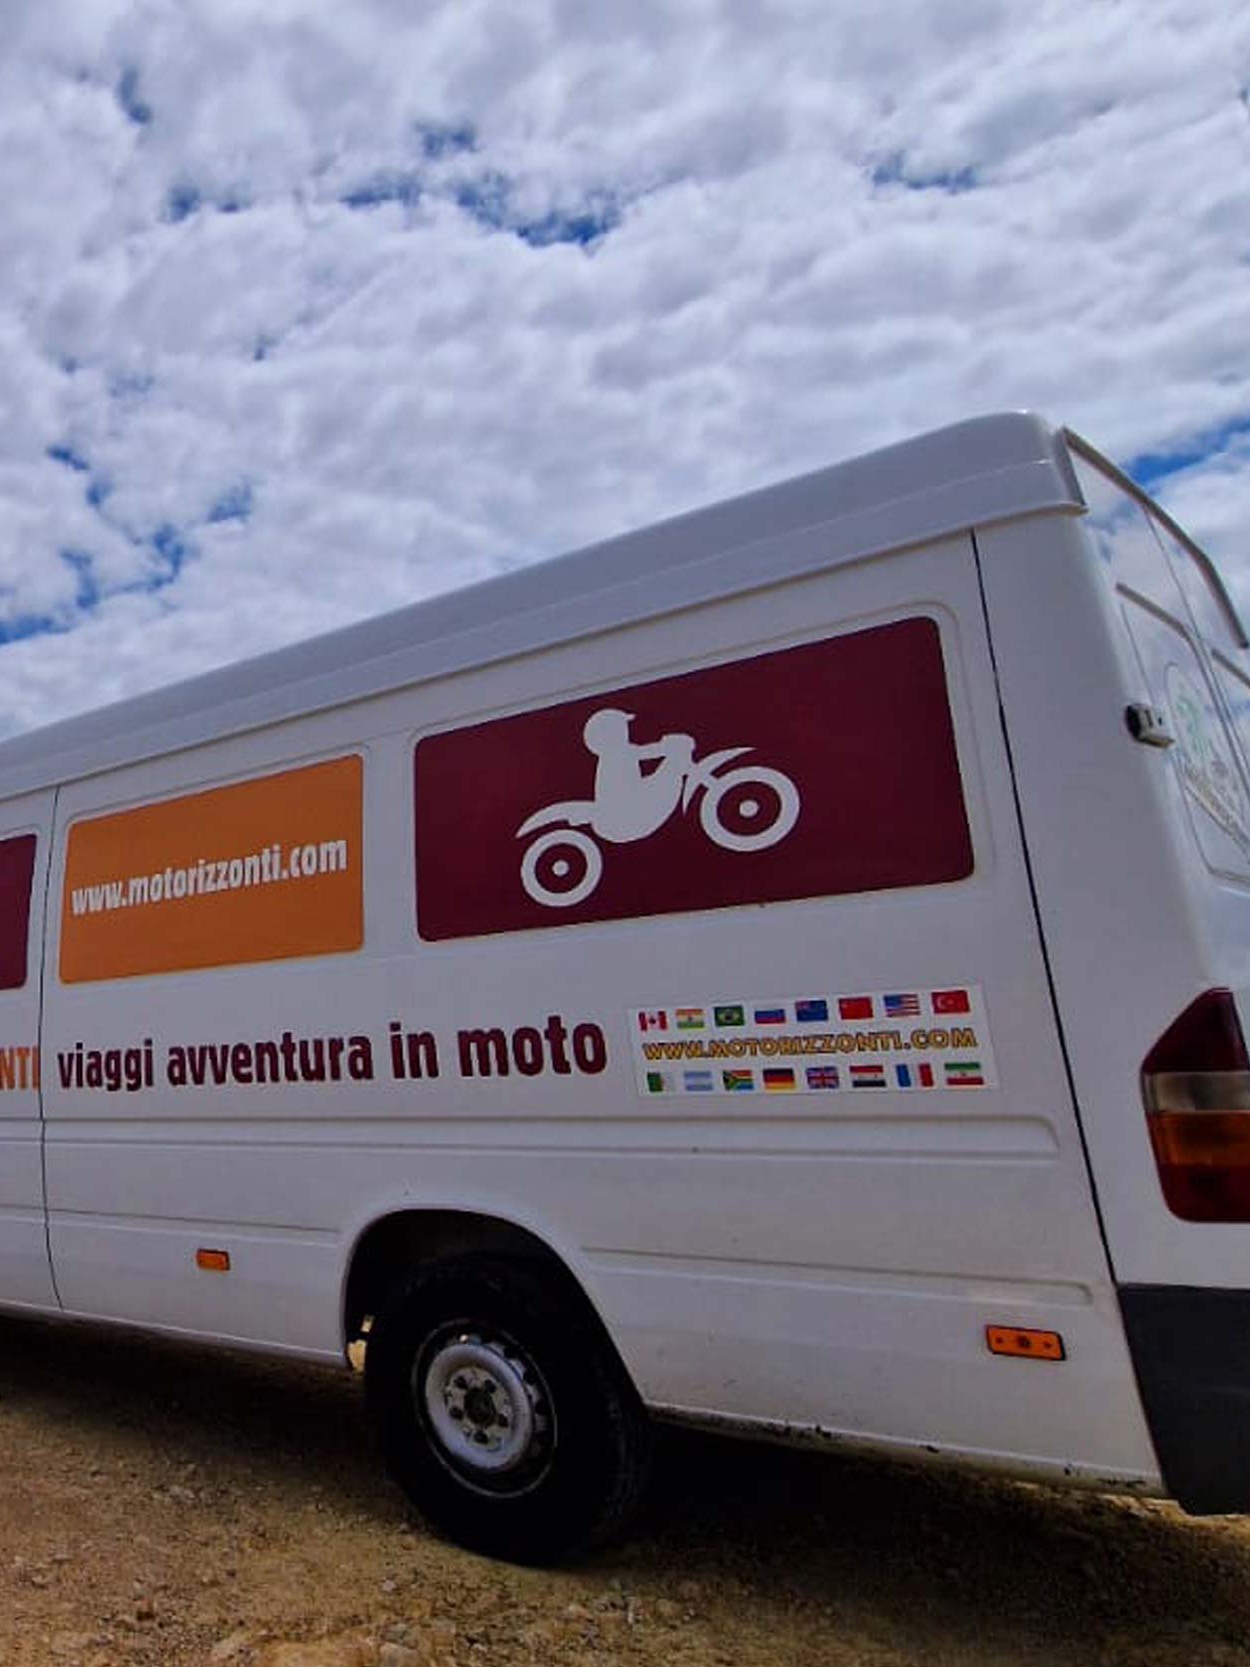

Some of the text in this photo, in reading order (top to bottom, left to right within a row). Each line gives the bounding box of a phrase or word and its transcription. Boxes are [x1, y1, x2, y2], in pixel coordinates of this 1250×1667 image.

[71, 839, 348, 916] www.motorizzonti.com
[56, 1015, 608, 1092] viaggi avventura in moto
[642, 1027, 978, 1061] WWW.MOTORIZZONTI.COM
